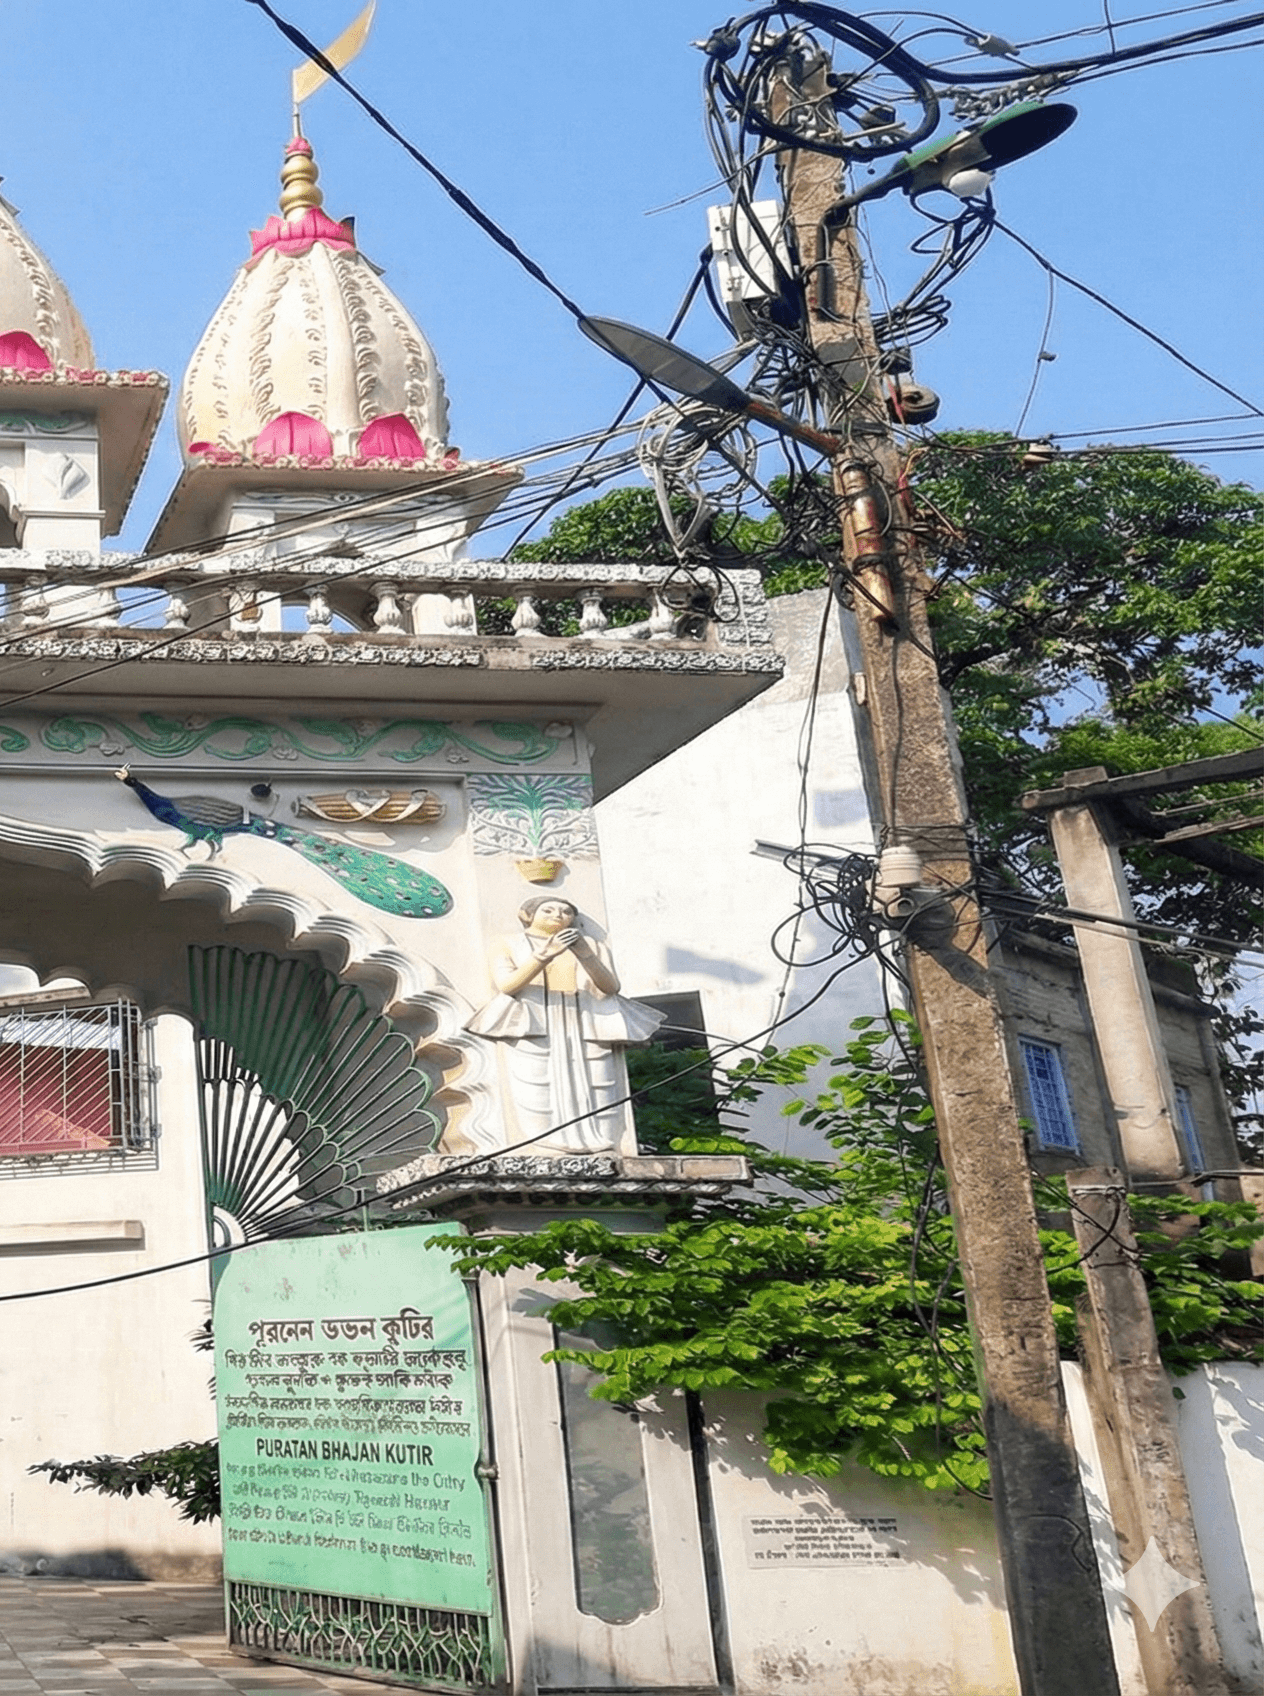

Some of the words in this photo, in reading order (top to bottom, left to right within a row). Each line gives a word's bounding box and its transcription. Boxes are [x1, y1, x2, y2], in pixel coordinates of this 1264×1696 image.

[256, 1437, 319, 1460] PURATAN
[321, 1440, 381, 1463] BHAJAN
[385, 1443, 434, 1467] KUTIR
